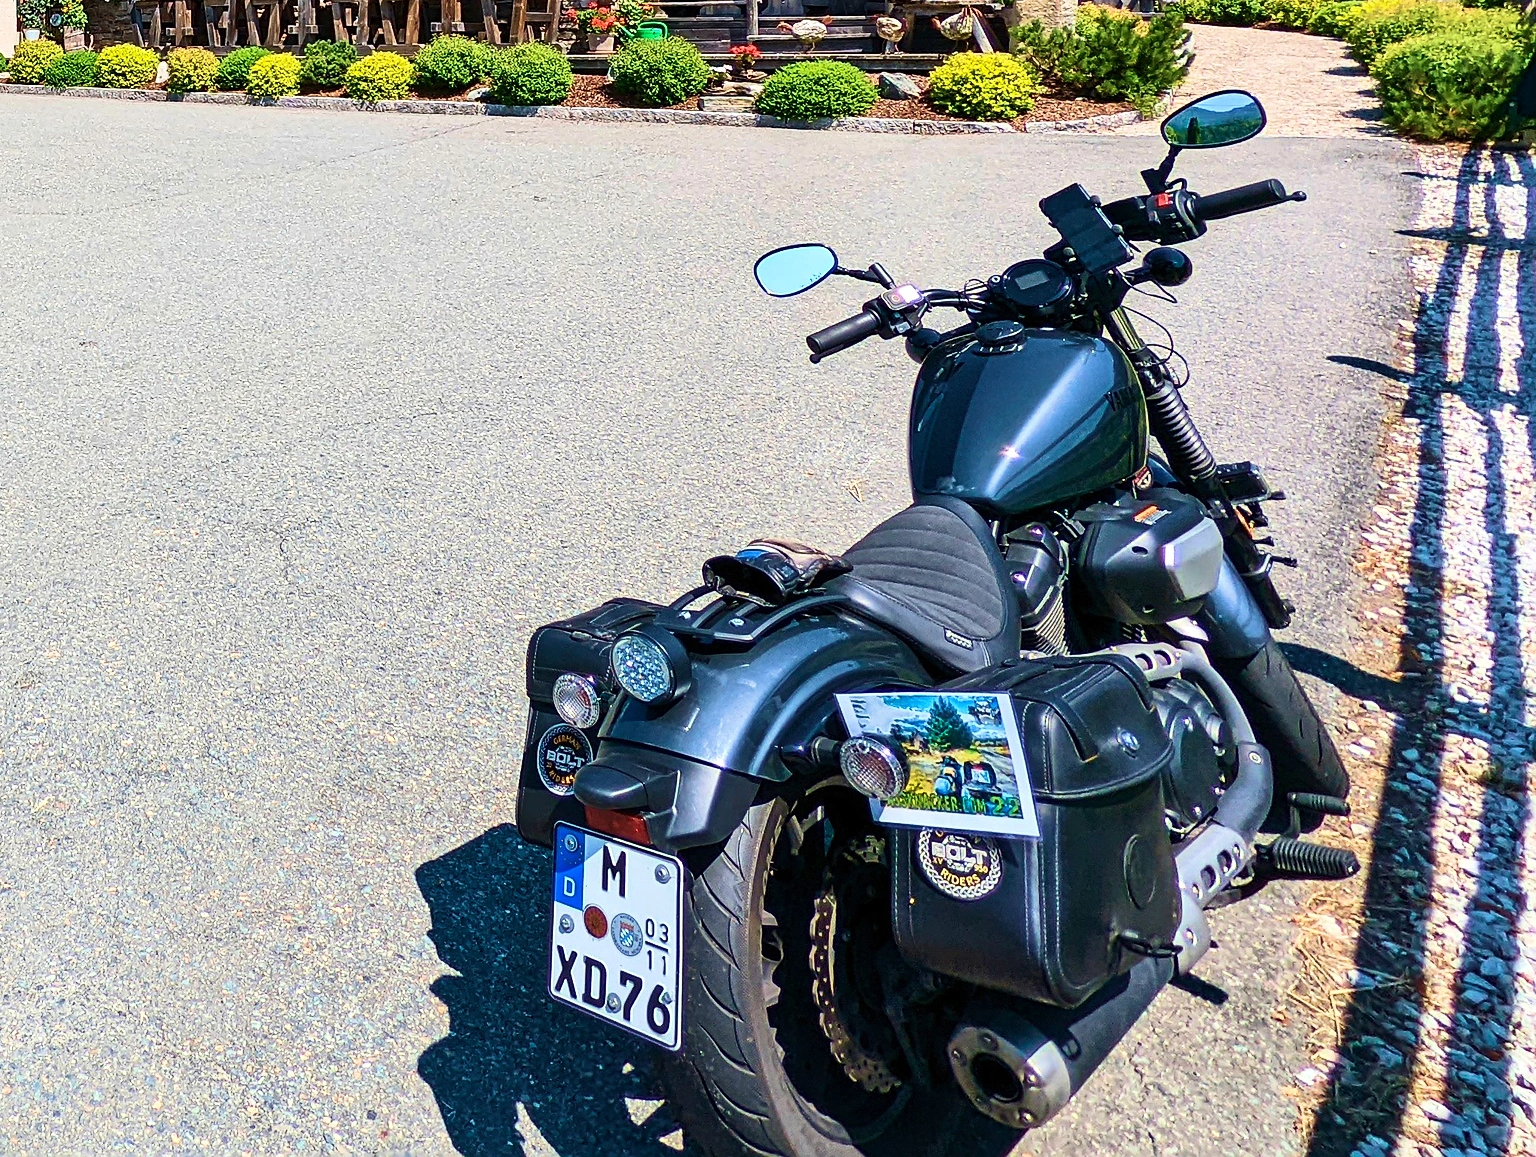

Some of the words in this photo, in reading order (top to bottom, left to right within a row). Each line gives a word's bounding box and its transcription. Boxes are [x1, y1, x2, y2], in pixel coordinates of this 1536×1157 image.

[553, 735, 582, 750] GERMAN
[546, 749, 585, 768] BOLT
[989, 795, 1022, 817] 22
[931, 841, 988, 866] BOLT
[932, 857, 945, 865] XV
[602, 844, 626, 898] M
[940, 867, 981, 887] RIDERS
[564, 876, 576, 897] D
[645, 918, 669, 943] 03
[647, 949, 667, 976] 11
[554, 944, 608, 1009] XD
[619, 970, 671, 1035] 76
